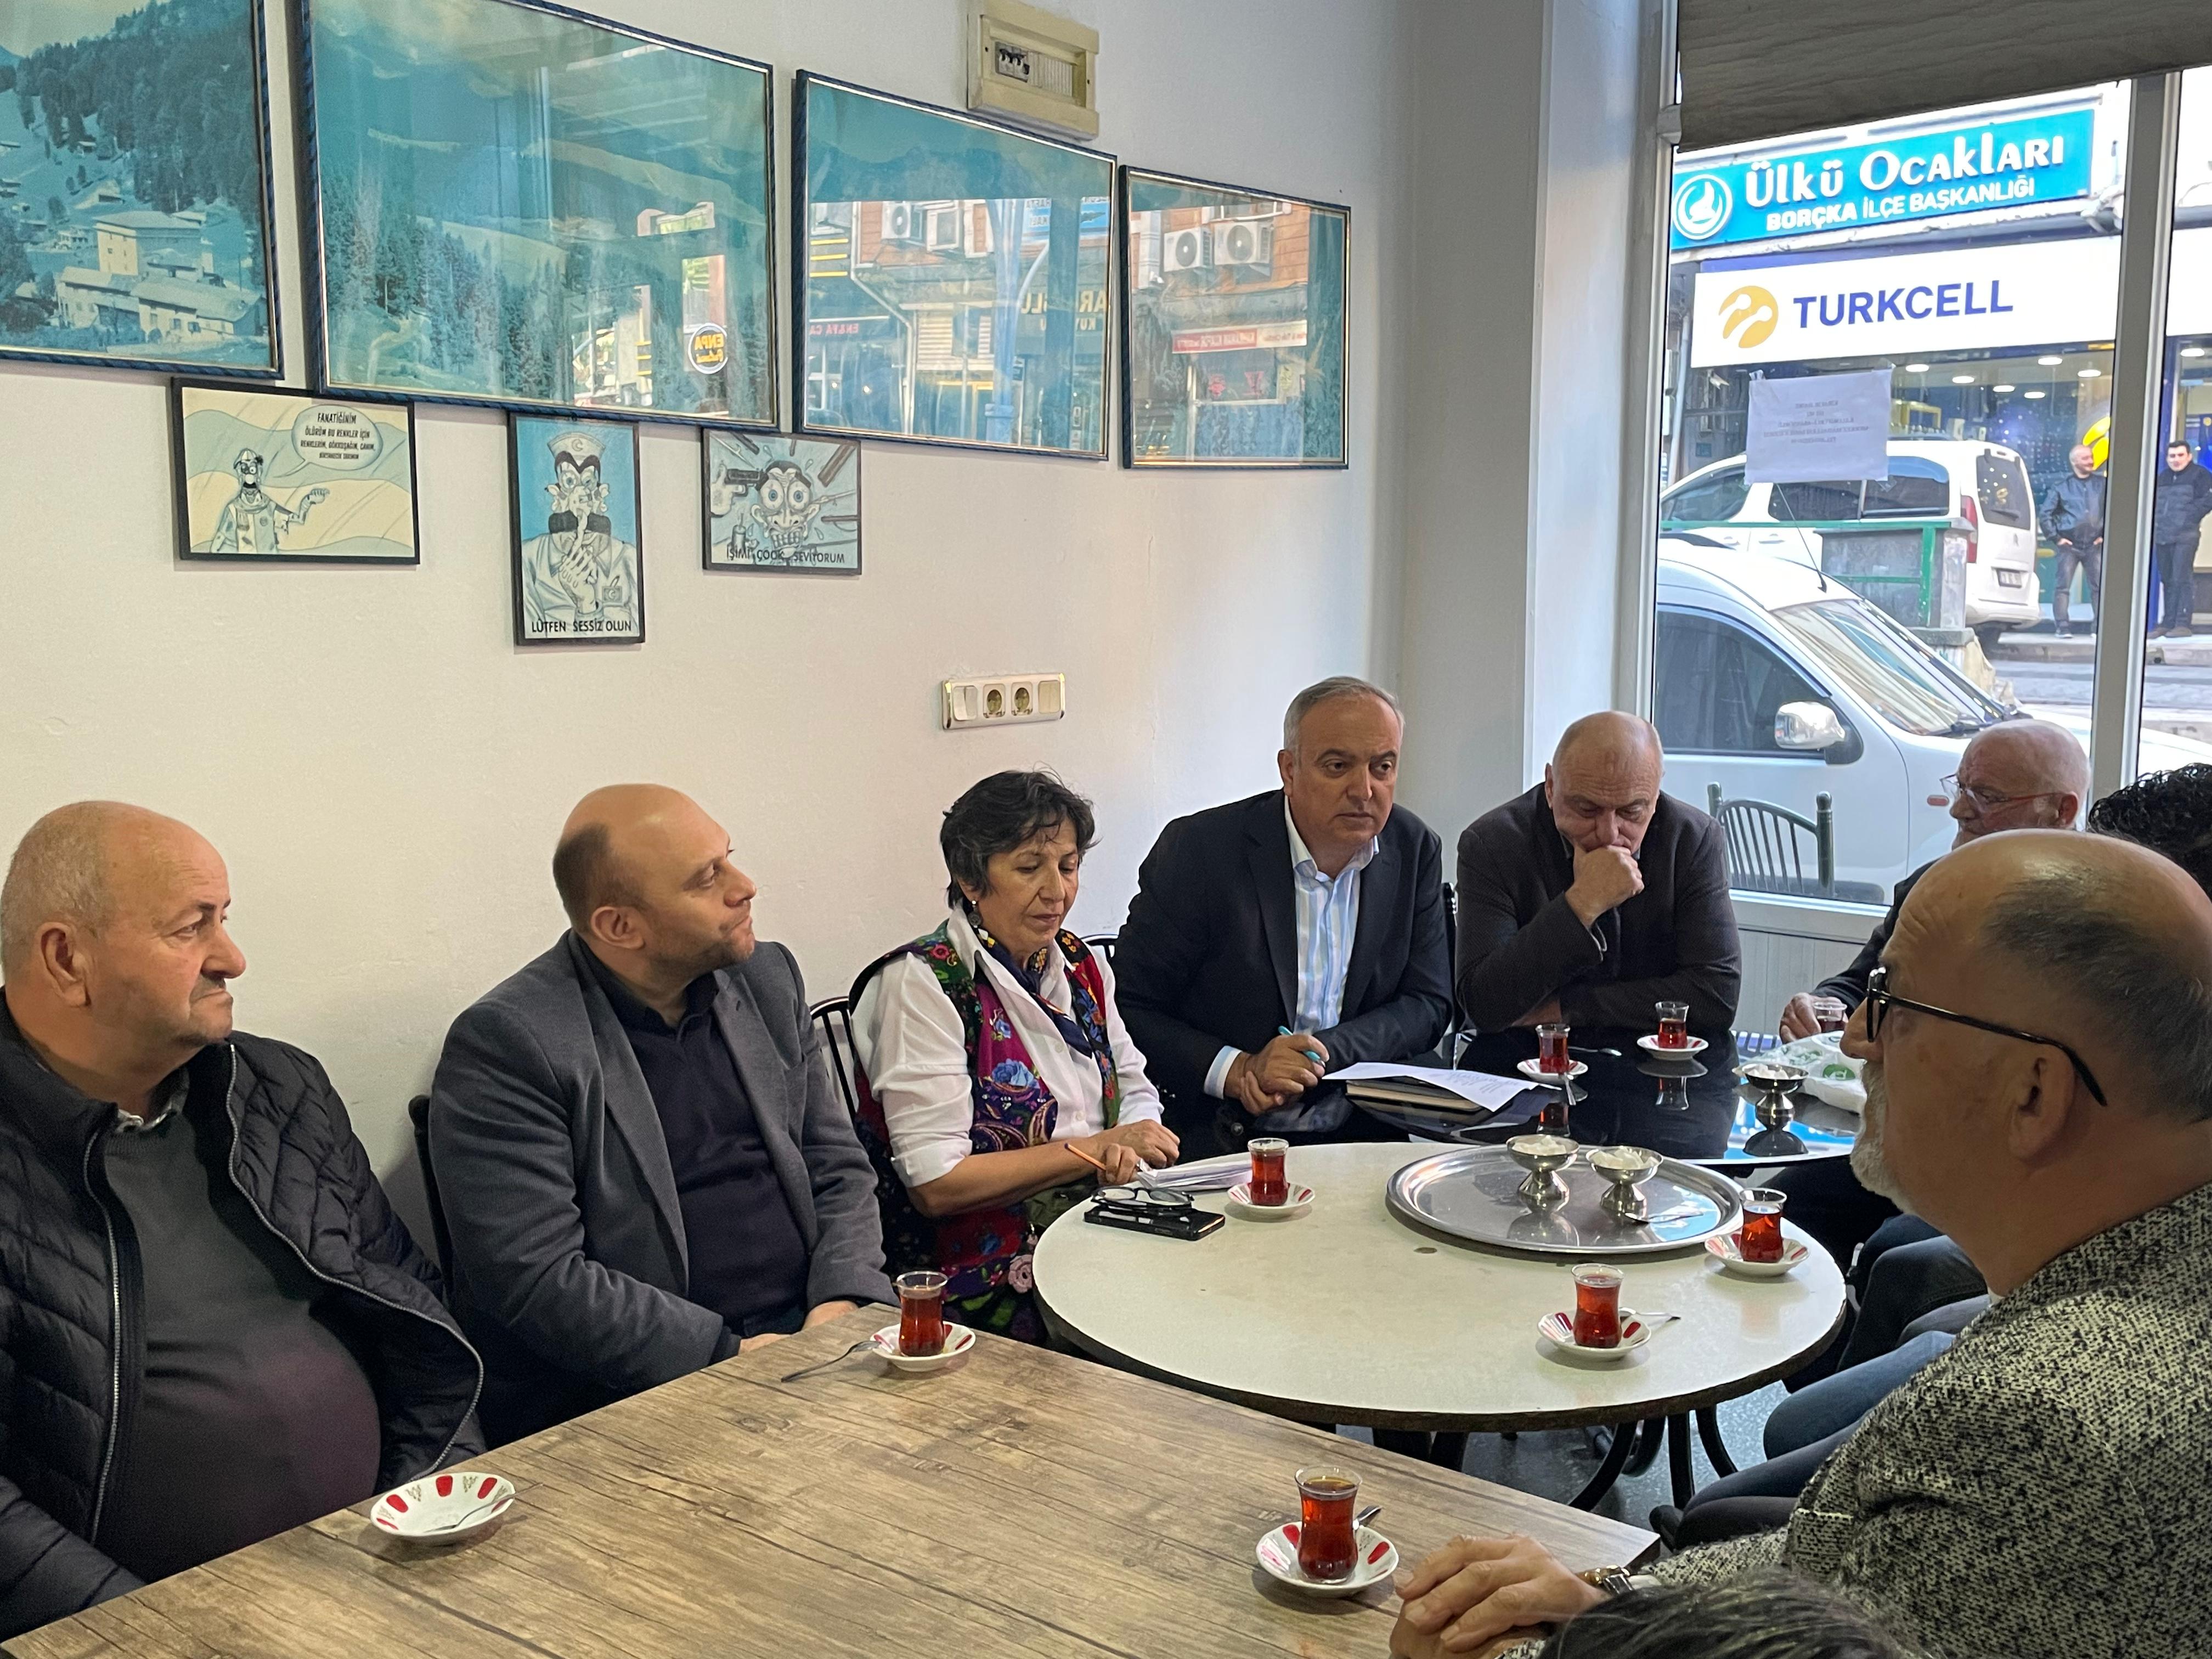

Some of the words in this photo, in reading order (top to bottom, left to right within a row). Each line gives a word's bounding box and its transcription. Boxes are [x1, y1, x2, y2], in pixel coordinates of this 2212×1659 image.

[1766, 202, 1858, 232] BORÇKA
[1863, 195, 1905, 218] İLÇE
[1909, 174, 2035, 212] BAŞKANLIĞI
[1793, 280, 2013, 329] TURKCELL
[336, 429, 358, 438] RENKLER
[532, 618, 566, 633] LÜTFEN
[573, 618, 603, 631] SESSİZ
[606, 620, 631, 631] OLUN
